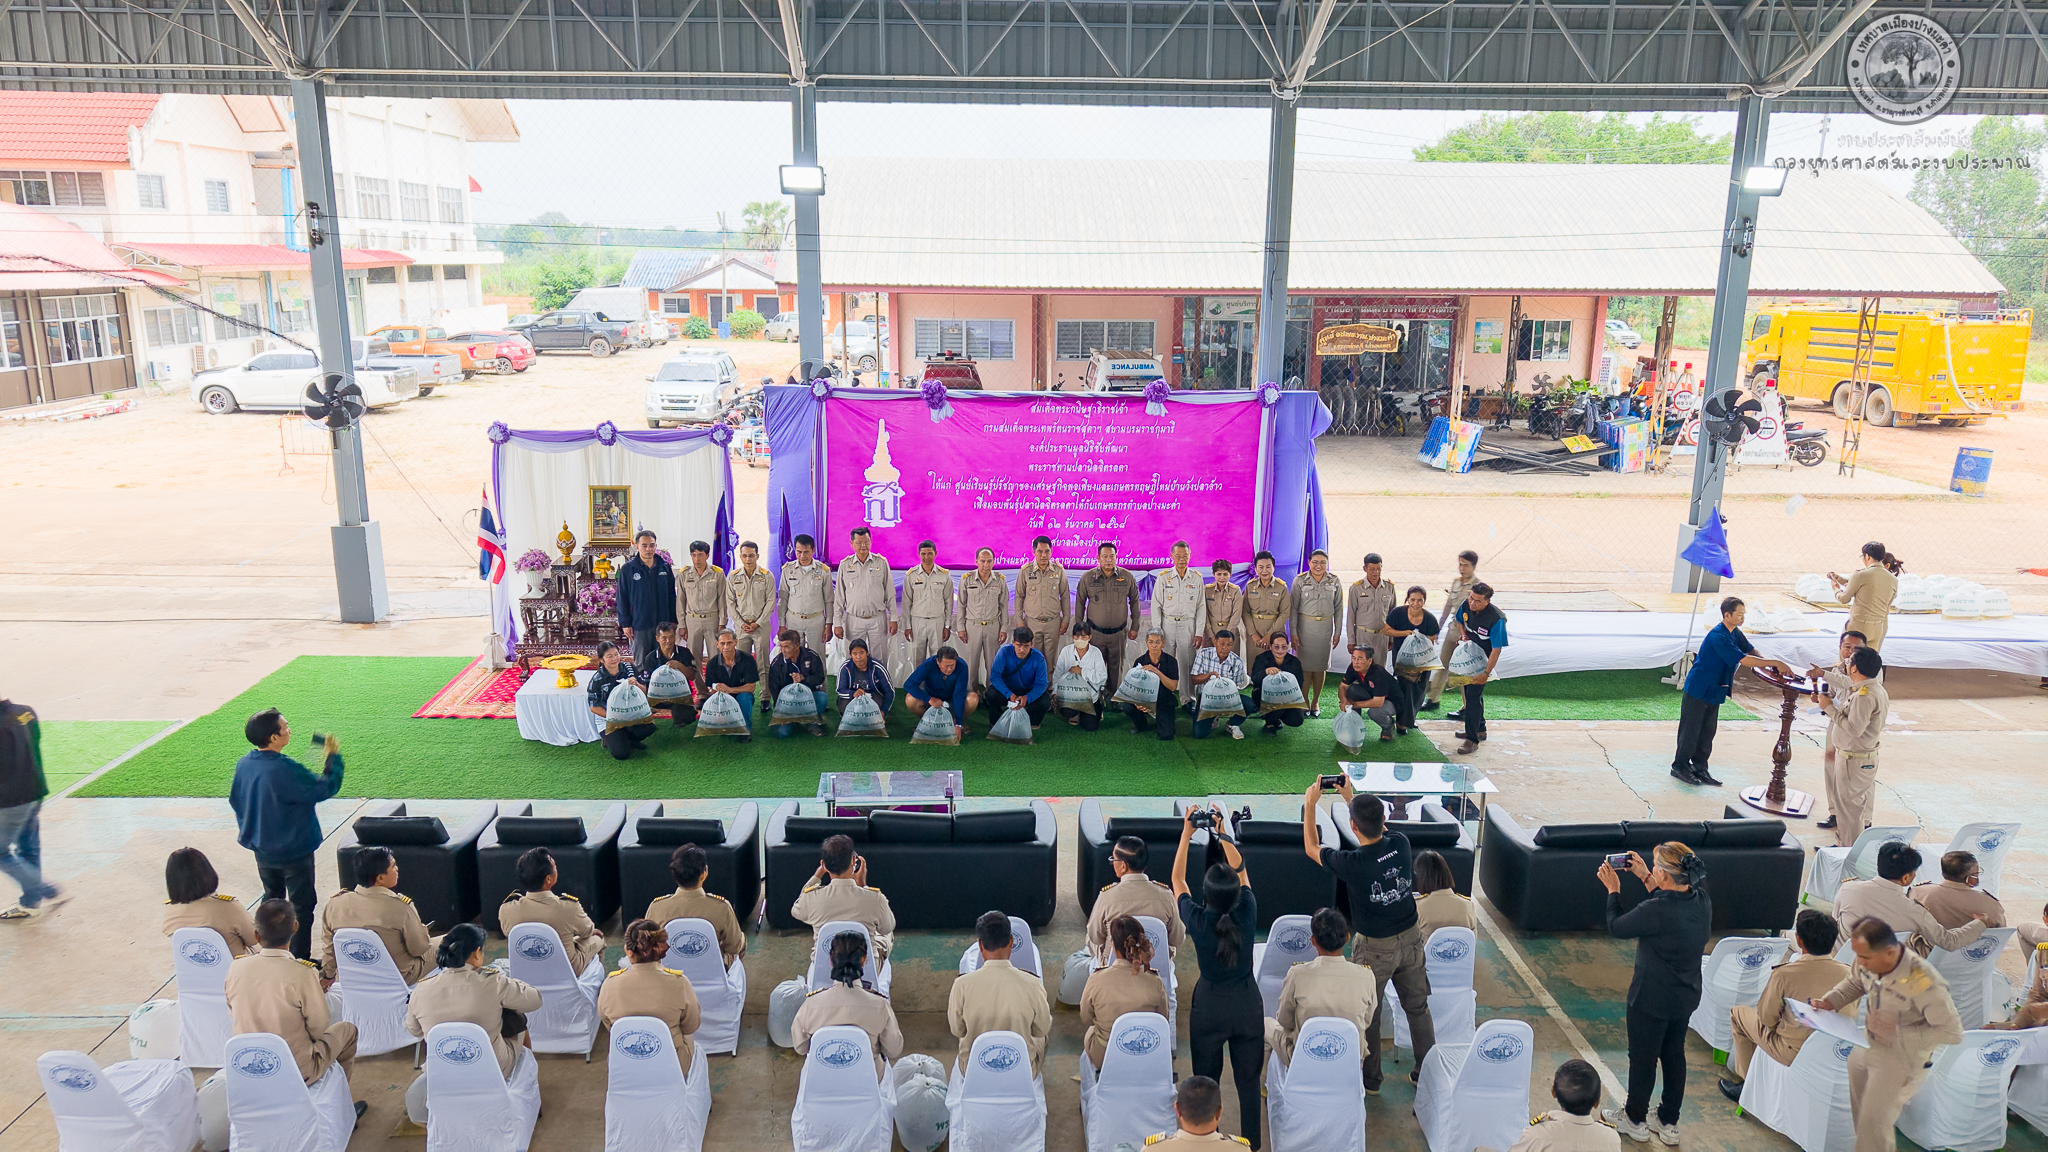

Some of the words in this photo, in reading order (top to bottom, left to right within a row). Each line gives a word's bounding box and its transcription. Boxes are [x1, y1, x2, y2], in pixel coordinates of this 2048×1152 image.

[1030, 399, 1129, 418] สมเด็จพระกนิษฐาธิราชเจ้า
[983, 417, 1102, 439] กรมสมเด็จพระเทพรัตนราชสุดาฯ
[1104, 418, 1176, 439] สยามบรมราชกุมารี
[1029, 436, 1129, 458] องค์ประธานมูลนิธิชัยพัฒนา
[1028, 457, 1129, 473] พระราชทานปลานิลจิตรลดา
[927, 470, 952, 490] ให้แก่
[1027, 512, 1046, 528] วันที่
[1047, 517, 1061, 529] ๑๒
[1064, 513, 1095, 529] ธันวาคม
[1095, 515, 1130, 529] ๒๕๖๘
